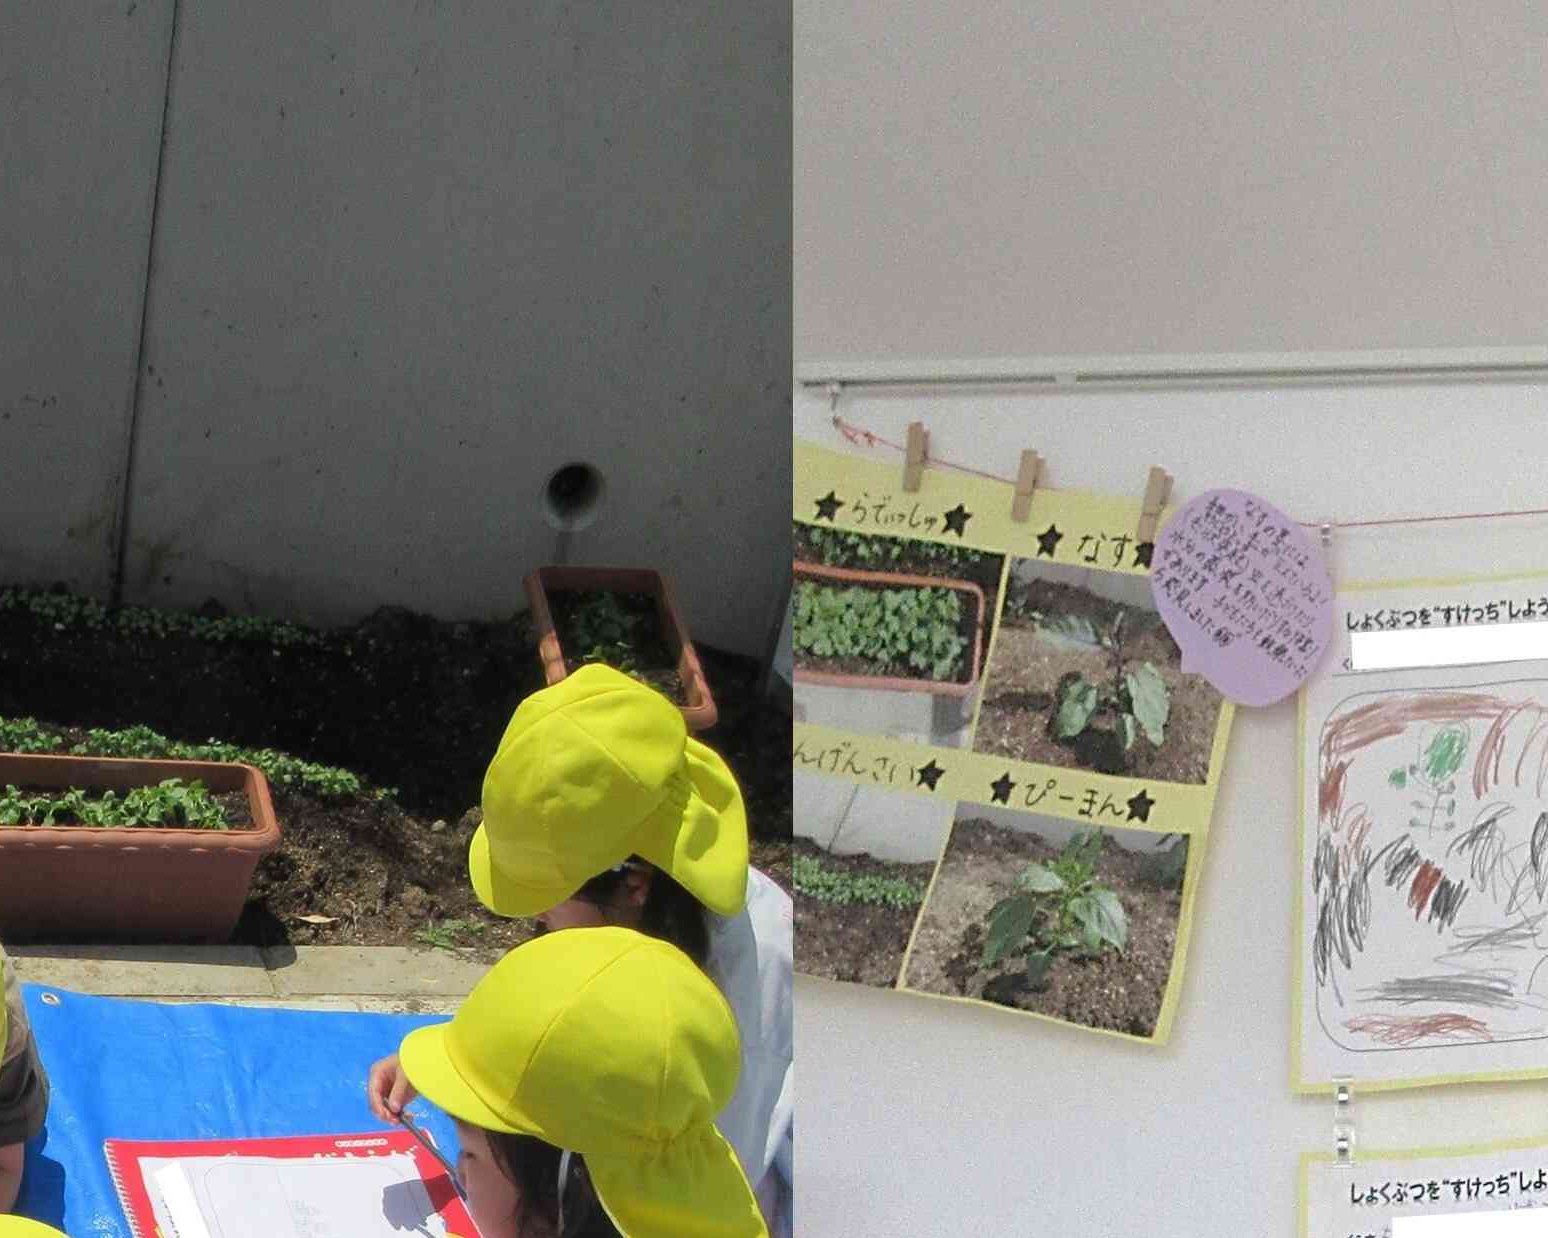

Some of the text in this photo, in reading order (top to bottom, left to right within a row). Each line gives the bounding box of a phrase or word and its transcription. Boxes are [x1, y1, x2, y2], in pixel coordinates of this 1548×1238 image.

[1078, 533, 1132, 566] なす
[1025, 779, 1124, 817] ぴーまん
